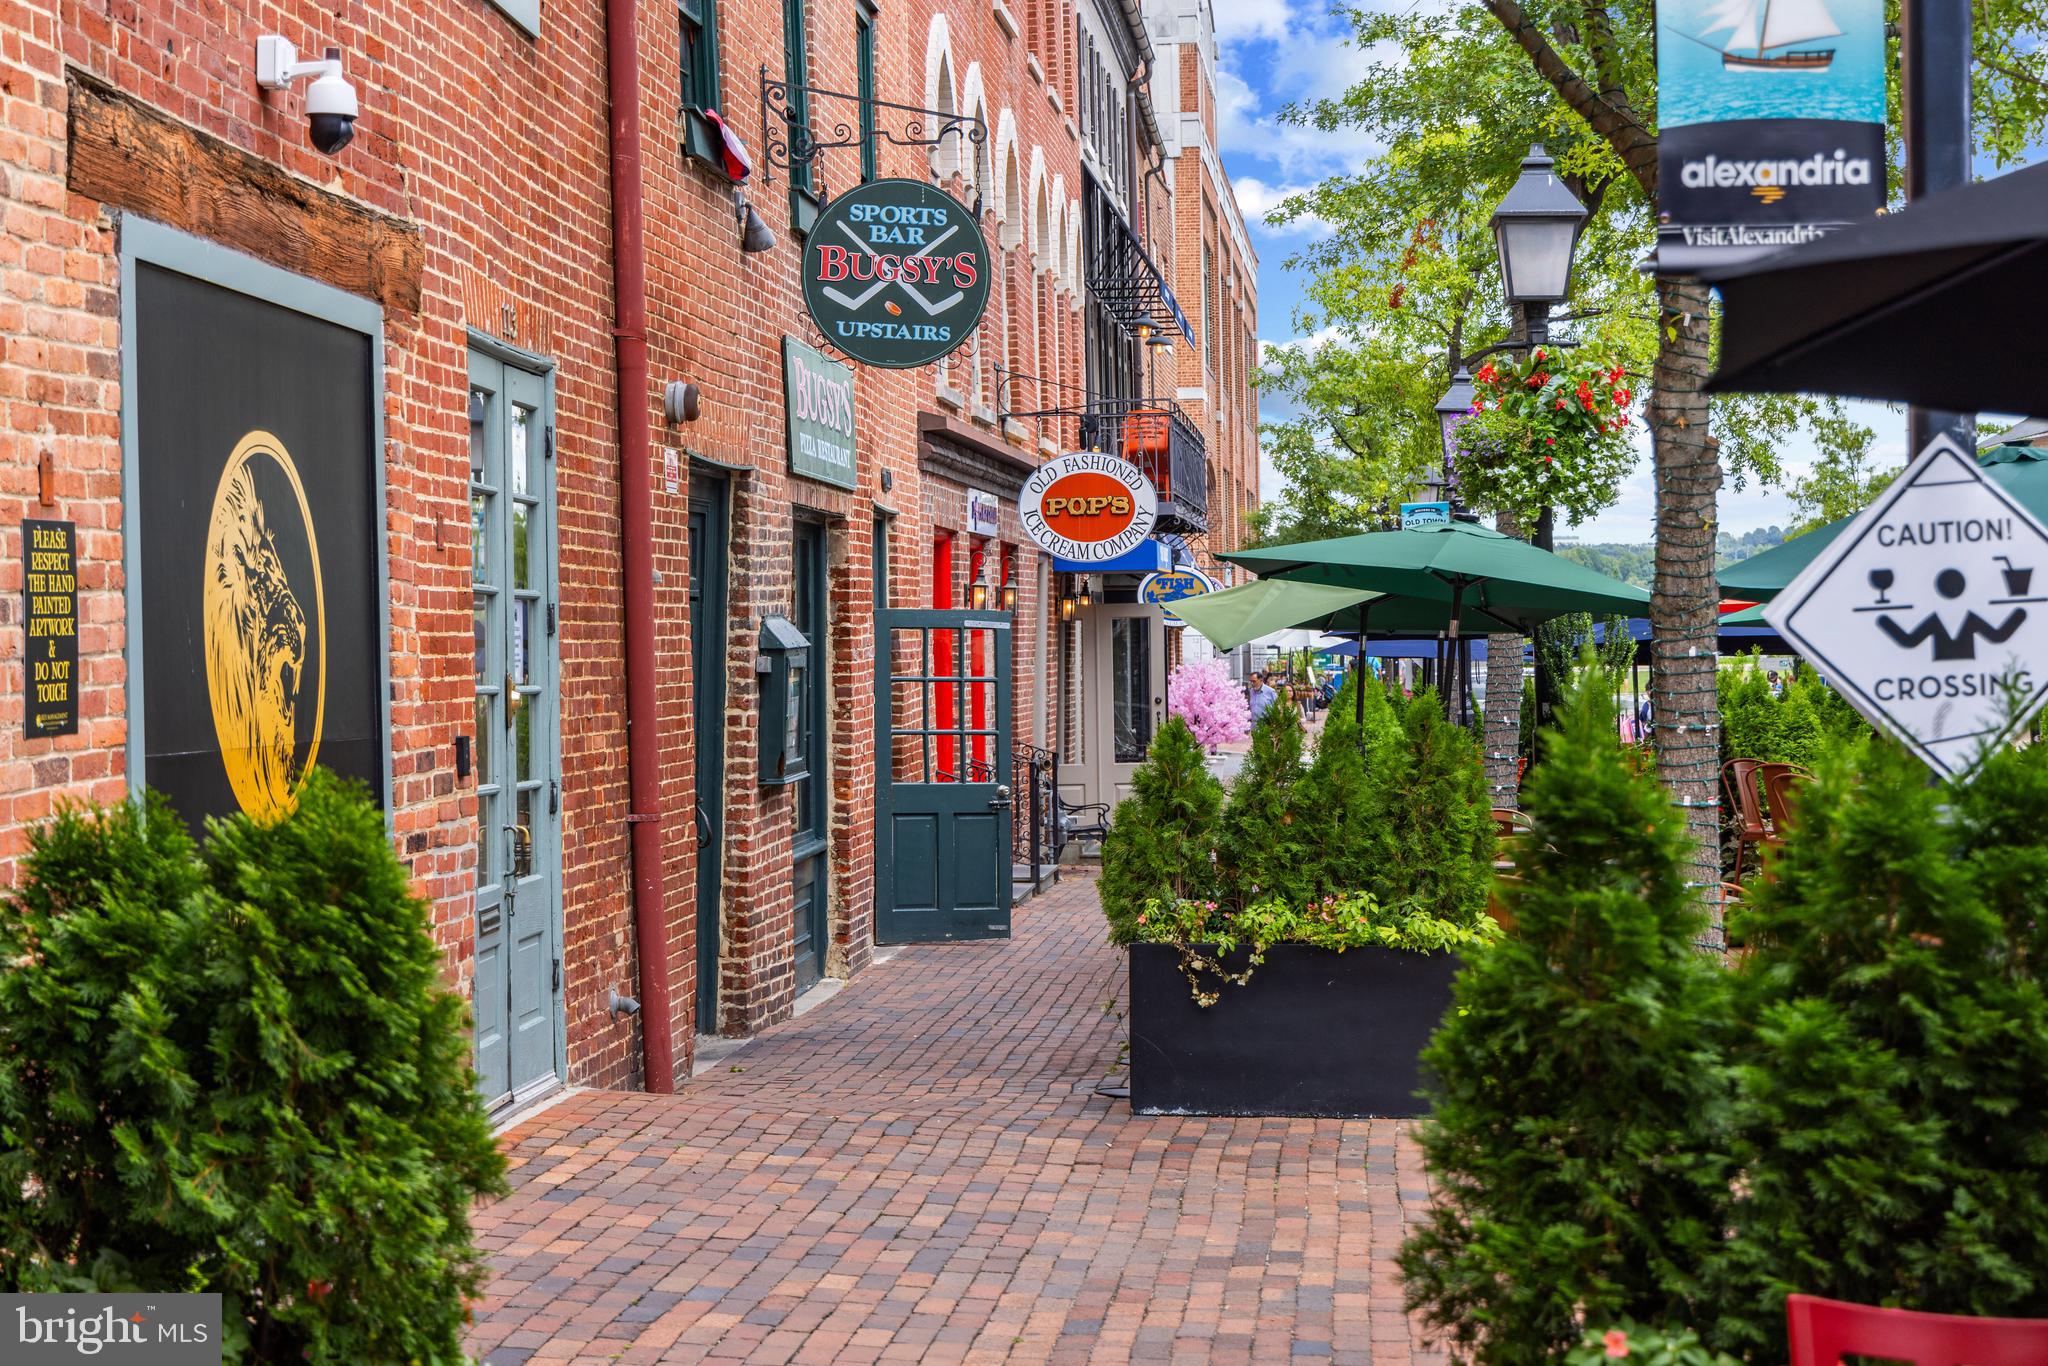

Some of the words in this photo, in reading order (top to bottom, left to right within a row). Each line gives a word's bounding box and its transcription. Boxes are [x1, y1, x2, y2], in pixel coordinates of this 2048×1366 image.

[1681, 149, 1870, 188] alexandria
[849, 204, 948, 227] SPORTS
[868, 225, 926, 245] BAR
[816, 245, 977, 289] BUGSY'S
[836, 321, 951, 342] UPSTAIRS
[793, 355, 852, 438] BUGSY'S
[800, 432, 817, 458] PIZZA
[817, 439, 851, 469] RESTAURANT
[1029, 467, 1058, 494] OLD
[1063, 455, 1143, 491] FASHIONED
[1045, 495, 1130, 516] POP'S
[1023, 508, 1046, 536] ICE
[1040, 530, 1090, 560] CREAM
[1093, 505, 1154, 560] COMPANY
[1405, 518, 1421, 526] OLD
[1877, 518, 2012, 547] CAUTION!
[33, 529, 67, 550] PLEASE
[31, 551, 70, 571] RESPECT
[28, 574, 46, 592] THE
[48, 574, 75, 593] HAND
[32, 596, 71, 615] PAINTED
[29, 617, 75, 637] ARTWORK
[48, 639, 56, 658] &
[34, 662, 49, 681] DO
[51, 661, 70, 680] NOT
[37, 683, 67, 703] TOUCH
[1874, 671, 2033, 701] CROSSING
